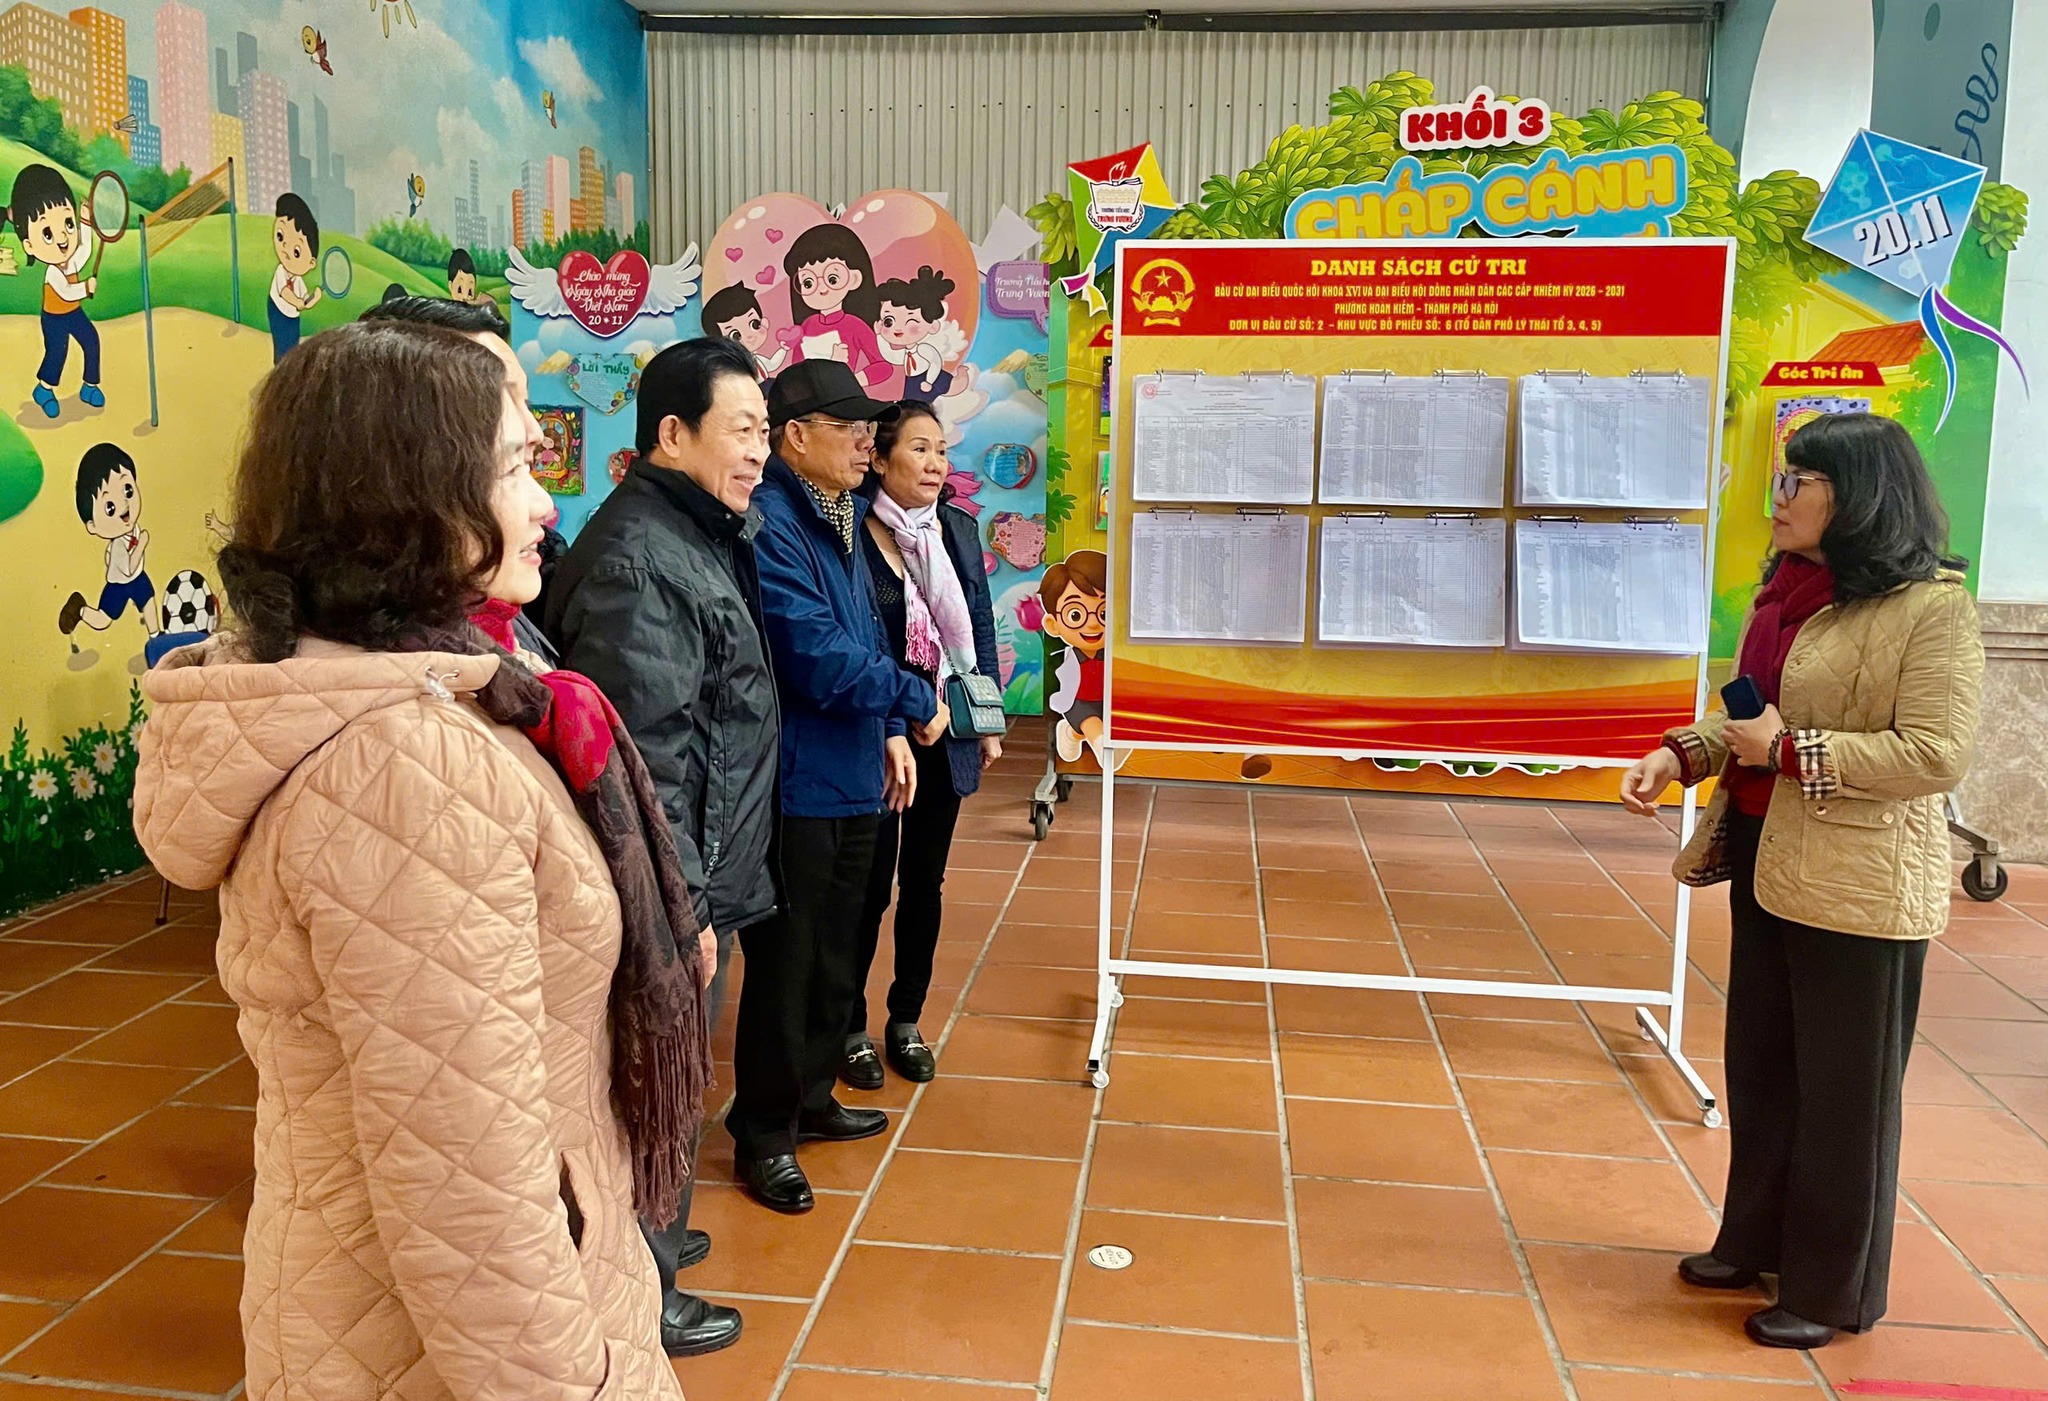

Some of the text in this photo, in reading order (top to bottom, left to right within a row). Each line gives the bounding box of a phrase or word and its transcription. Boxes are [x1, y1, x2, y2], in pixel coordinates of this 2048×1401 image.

[1407, 94, 1544, 143] KHỐI 3
[1485, 154, 1676, 225] CÁNH
[1853, 194, 1953, 267] 20.11
[1311, 255, 1527, 276] DANH SÁCH CỬ TRI
[1026, 287, 1050, 298] Vươn
[1215, 282, 1231, 297] BẦU
[1282, 282, 1304, 297] QUỐC
[1306, 283, 1320, 299] HỘI
[1322, 285, 1344, 297] KHOA
[1345, 285, 1361, 297] XVI
[1375, 286, 1389, 299] ĐẠI
[1391, 281, 1410, 297] BIỂU
[1412, 283, 1427, 299] HỘI
[1453, 282, 1476, 297] NHÂN
[1478, 282, 1494, 297] DÂN
[1496, 283, 1513, 297] CÁC
[1515, 282, 1531, 297] CẤP
[1533, 283, 1561, 298] NHIỆM
[1575, 285, 1596, 297] 2026
[1605, 285, 1625, 297] 2031
[1334, 301, 1367, 315] PHƯỜNG
[1369, 301, 1391, 315] HOÀN
[1393, 299, 1414, 315] KIẾM
[1424, 301, 1450, 315] THÀNH
[1452, 299, 1469, 315] PHỐ
[1471, 301, 1482, 315] HÀ
[1484, 301, 1499, 317] NỘI
[588, 316, 623, 325] 20 11
[1229, 319, 1248, 331] ĐƠN
[1262, 316, 1281, 331] BẦU
[1317, 320, 1324, 331] 2
[1337, 319, 1356, 331] KHU
[1358, 319, 1377, 333] VỰC
[1380, 316, 1393, 331] BỎ
[1395, 316, 1423, 331] PHIẾU
[1445, 320, 1452, 331] 6
[1472, 317, 1492, 331] DÂN
[1494, 316, 1513, 331] PHỐ
[1515, 317, 1527, 331] LÝ
[1529, 318, 1550, 331] THÁI
[1591, 320, 1602, 331] 5)
[1778, 366, 1809, 379] Góc
[1811, 366, 1837, 379] Tri
